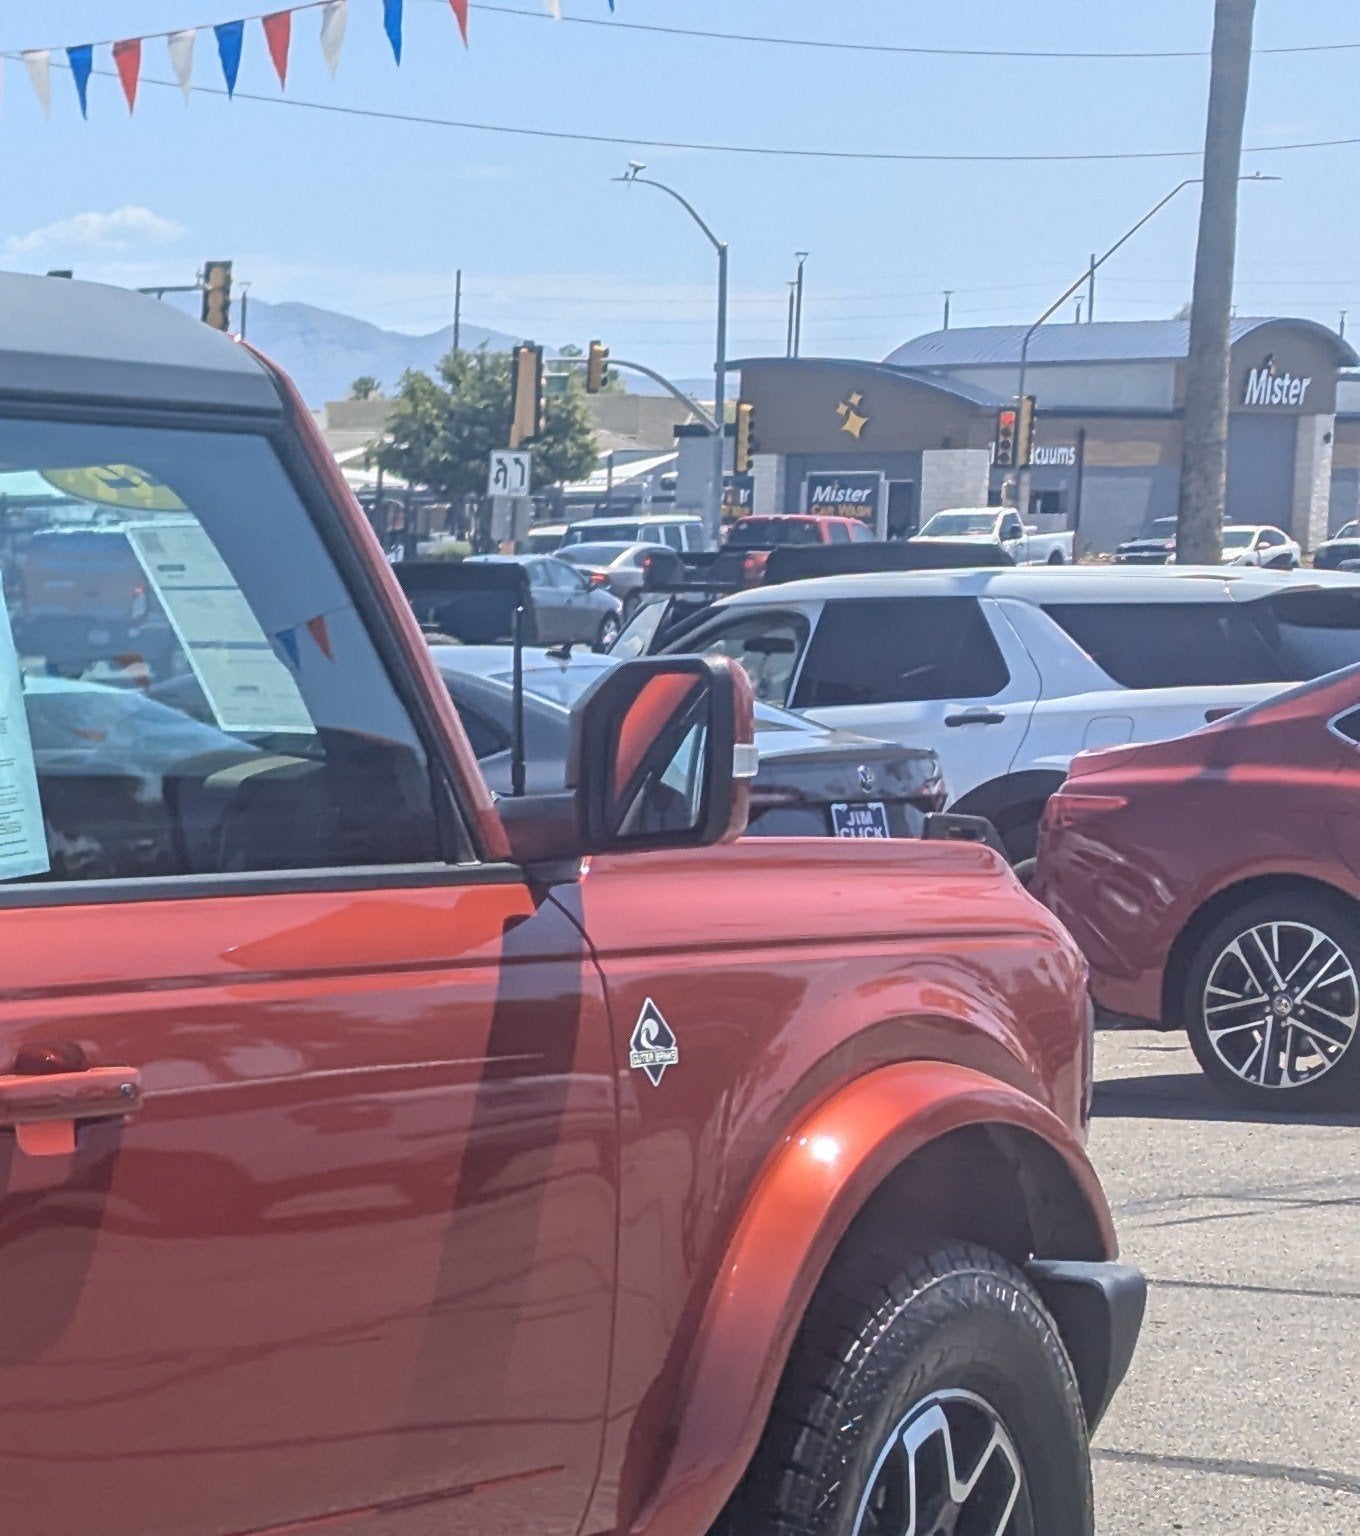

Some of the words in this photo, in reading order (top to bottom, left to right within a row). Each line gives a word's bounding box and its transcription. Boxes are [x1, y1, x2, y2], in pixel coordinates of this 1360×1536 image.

[1245, 367, 1311, 405] Mister
[812, 486, 871, 502] Mister
[846, 811, 874, 826] JIM
[840, 827, 884, 838] CLICK
